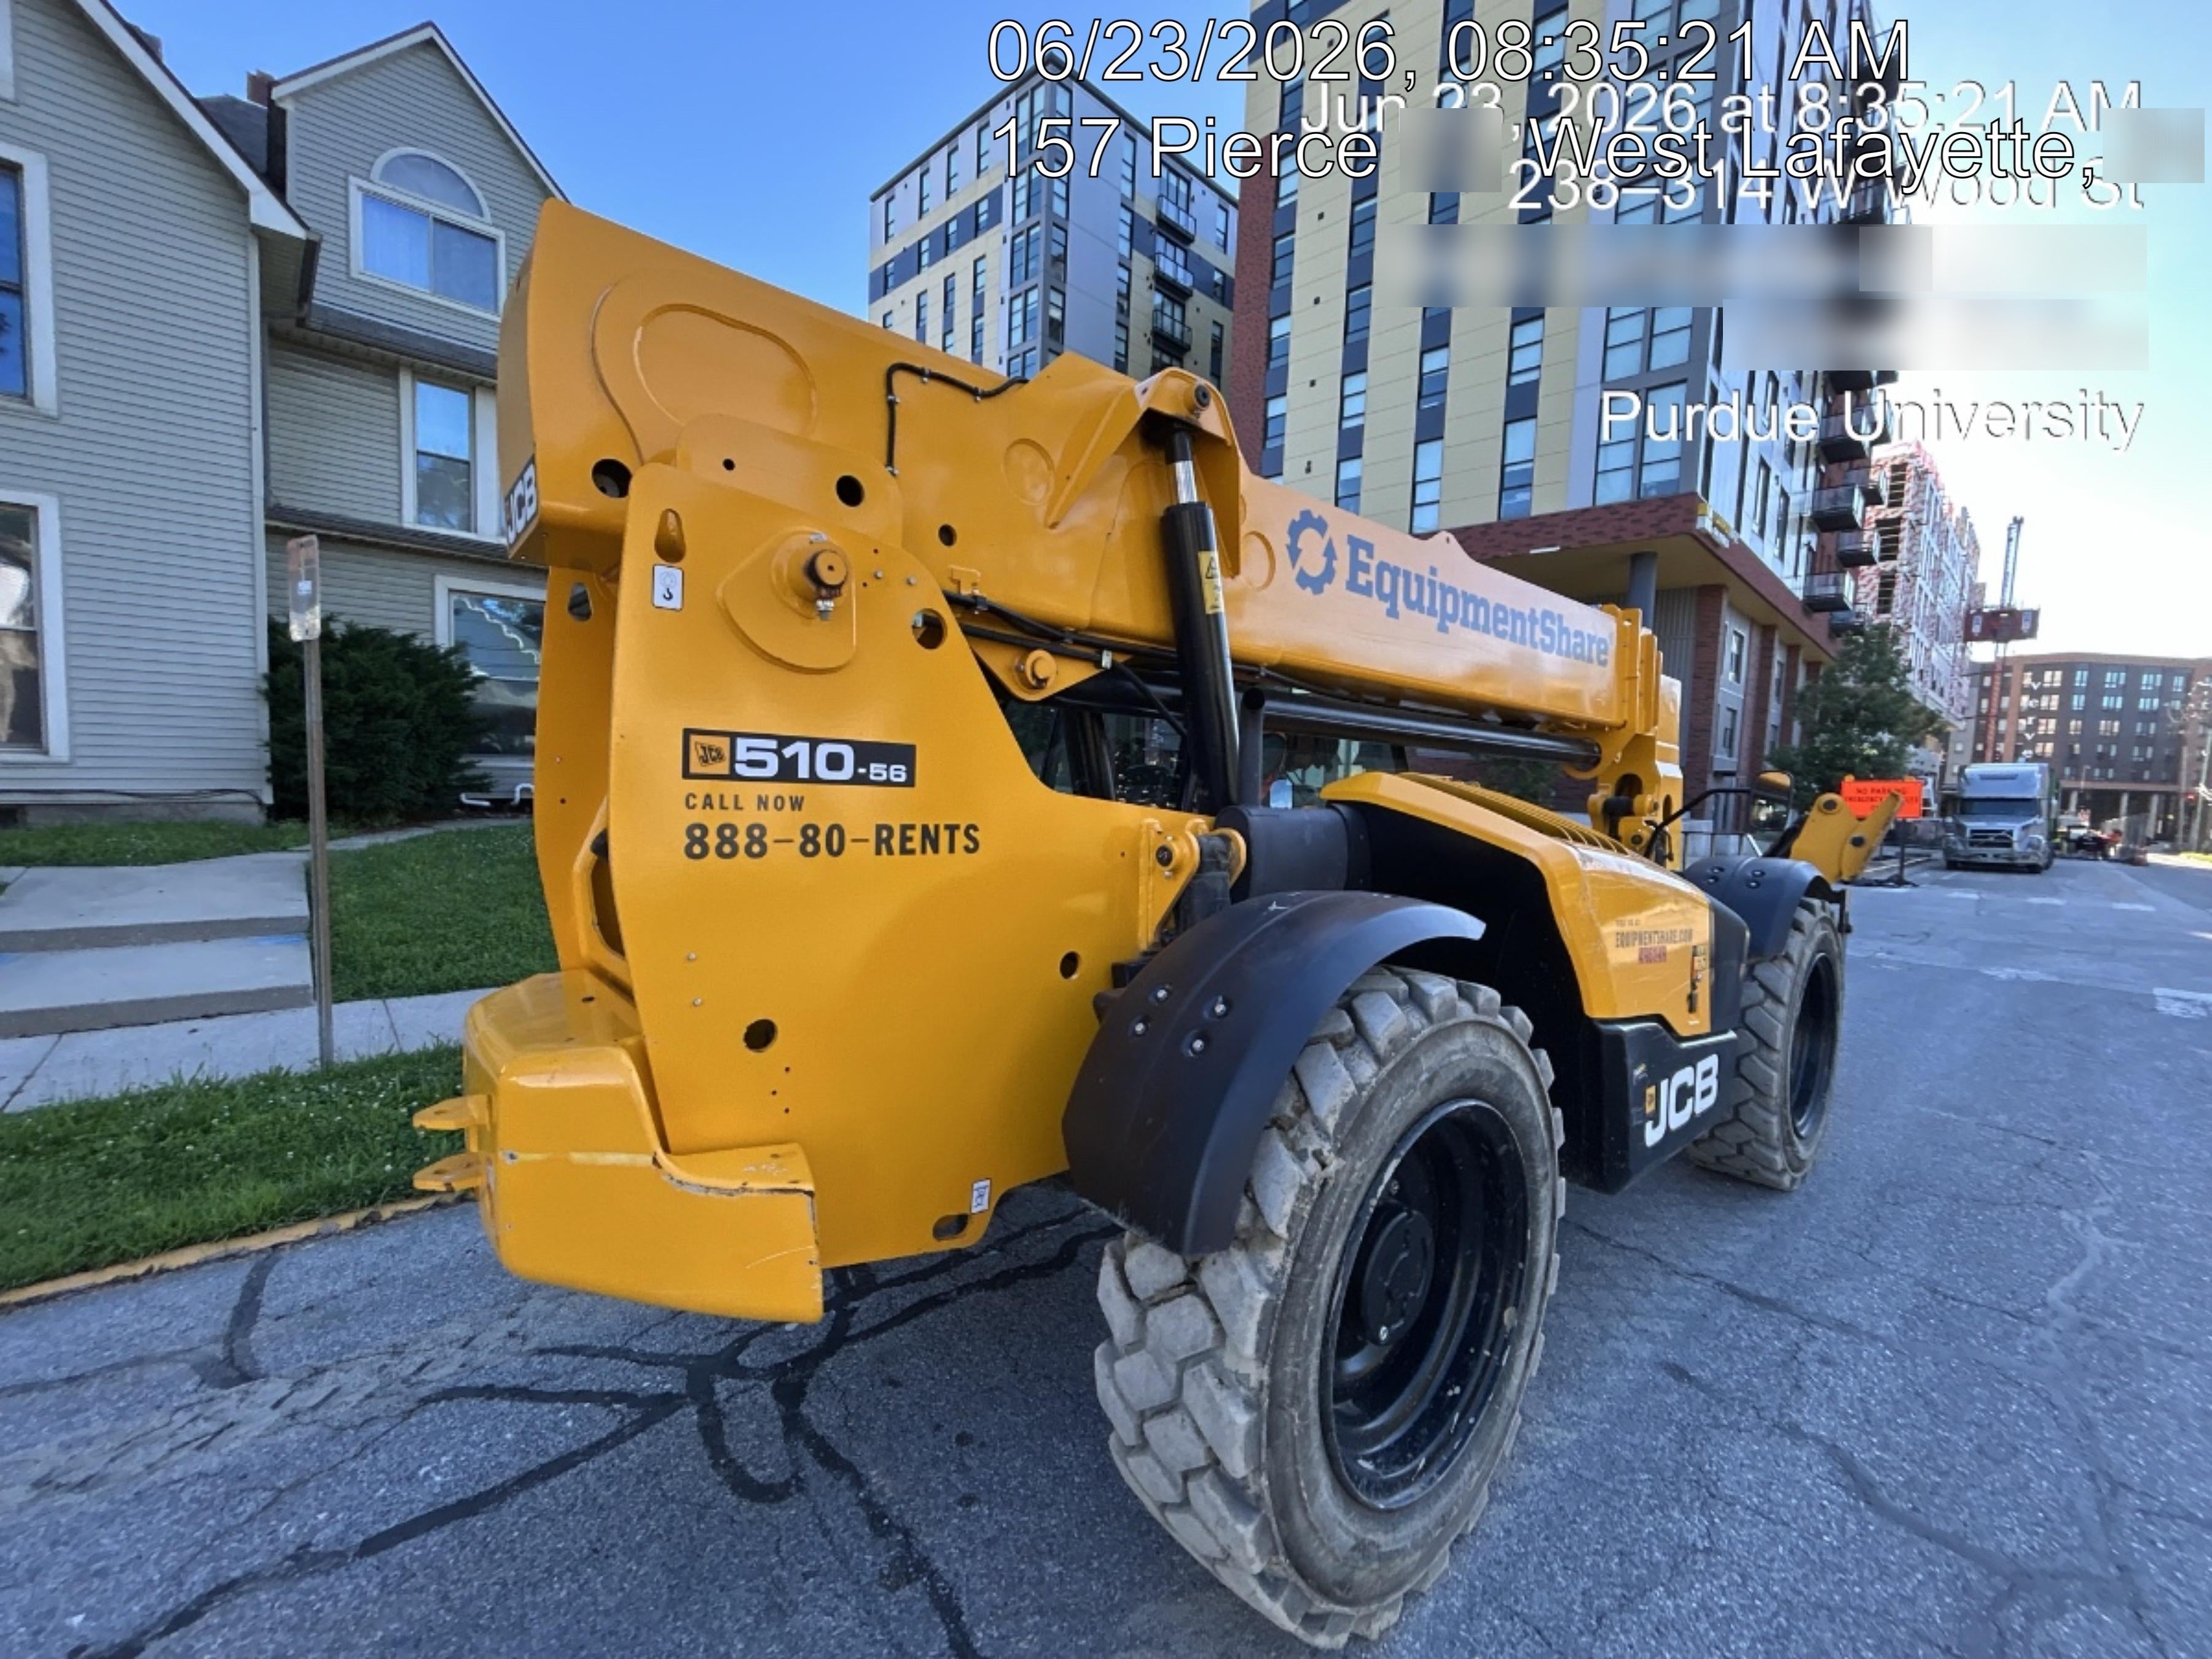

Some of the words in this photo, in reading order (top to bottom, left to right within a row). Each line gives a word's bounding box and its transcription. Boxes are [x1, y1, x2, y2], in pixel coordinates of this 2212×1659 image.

[506, 463, 538, 545] JCB
[1345, 533, 1609, 668] EquipmentShare
[734, 737, 908, 783] 510-56
[684, 793, 743, 810] CALL
[757, 794, 806, 812] NOW
[684, 822, 981, 860] 888-80-RENTS
[1644, 1054, 1719, 1148] JCB
